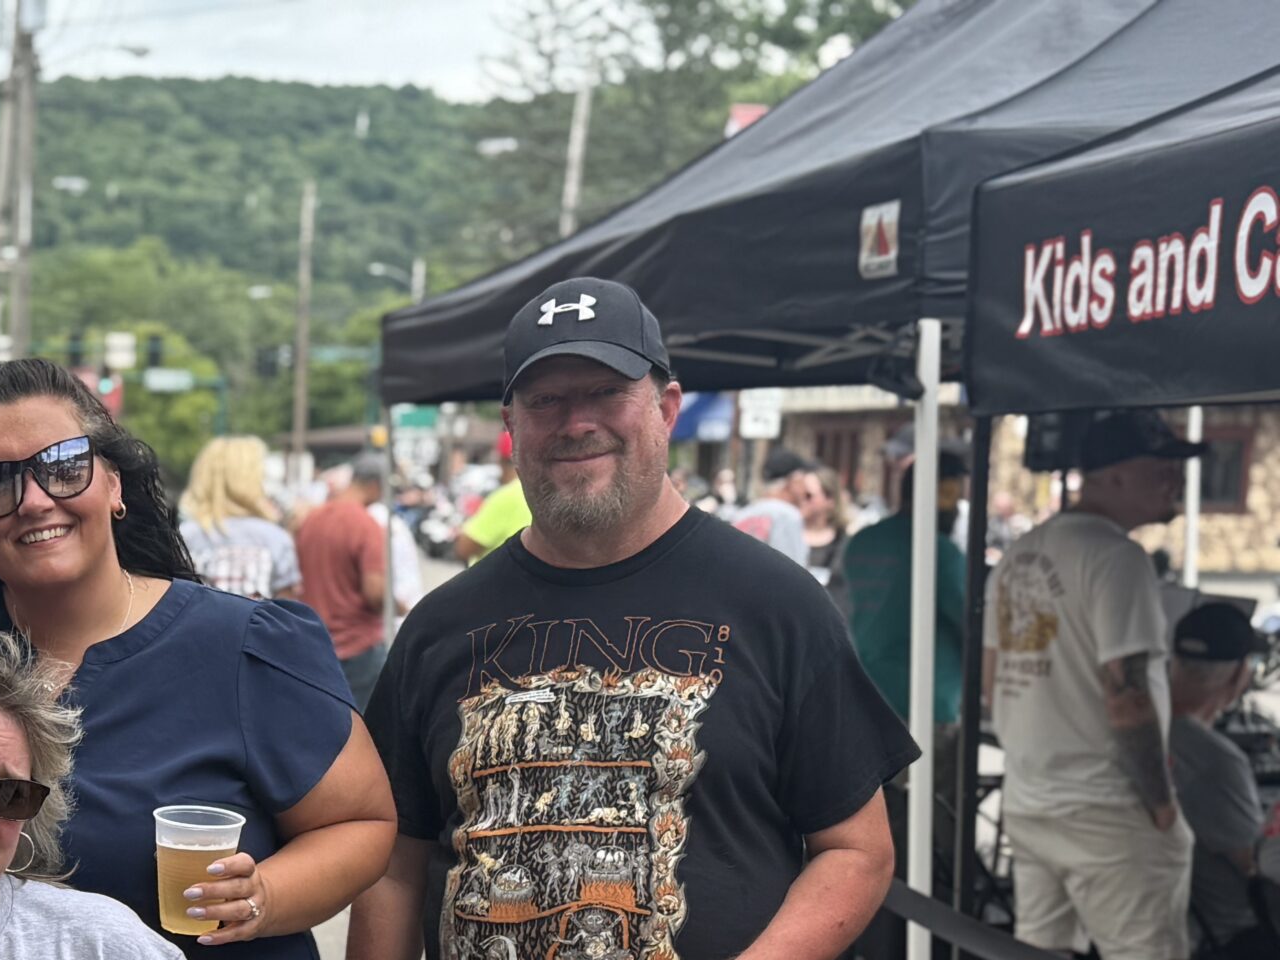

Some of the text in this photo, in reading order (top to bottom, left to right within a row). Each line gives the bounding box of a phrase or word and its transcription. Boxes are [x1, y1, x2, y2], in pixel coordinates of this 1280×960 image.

[1015, 184, 1280, 340] Kids and C
[457, 614, 714, 702] KING
